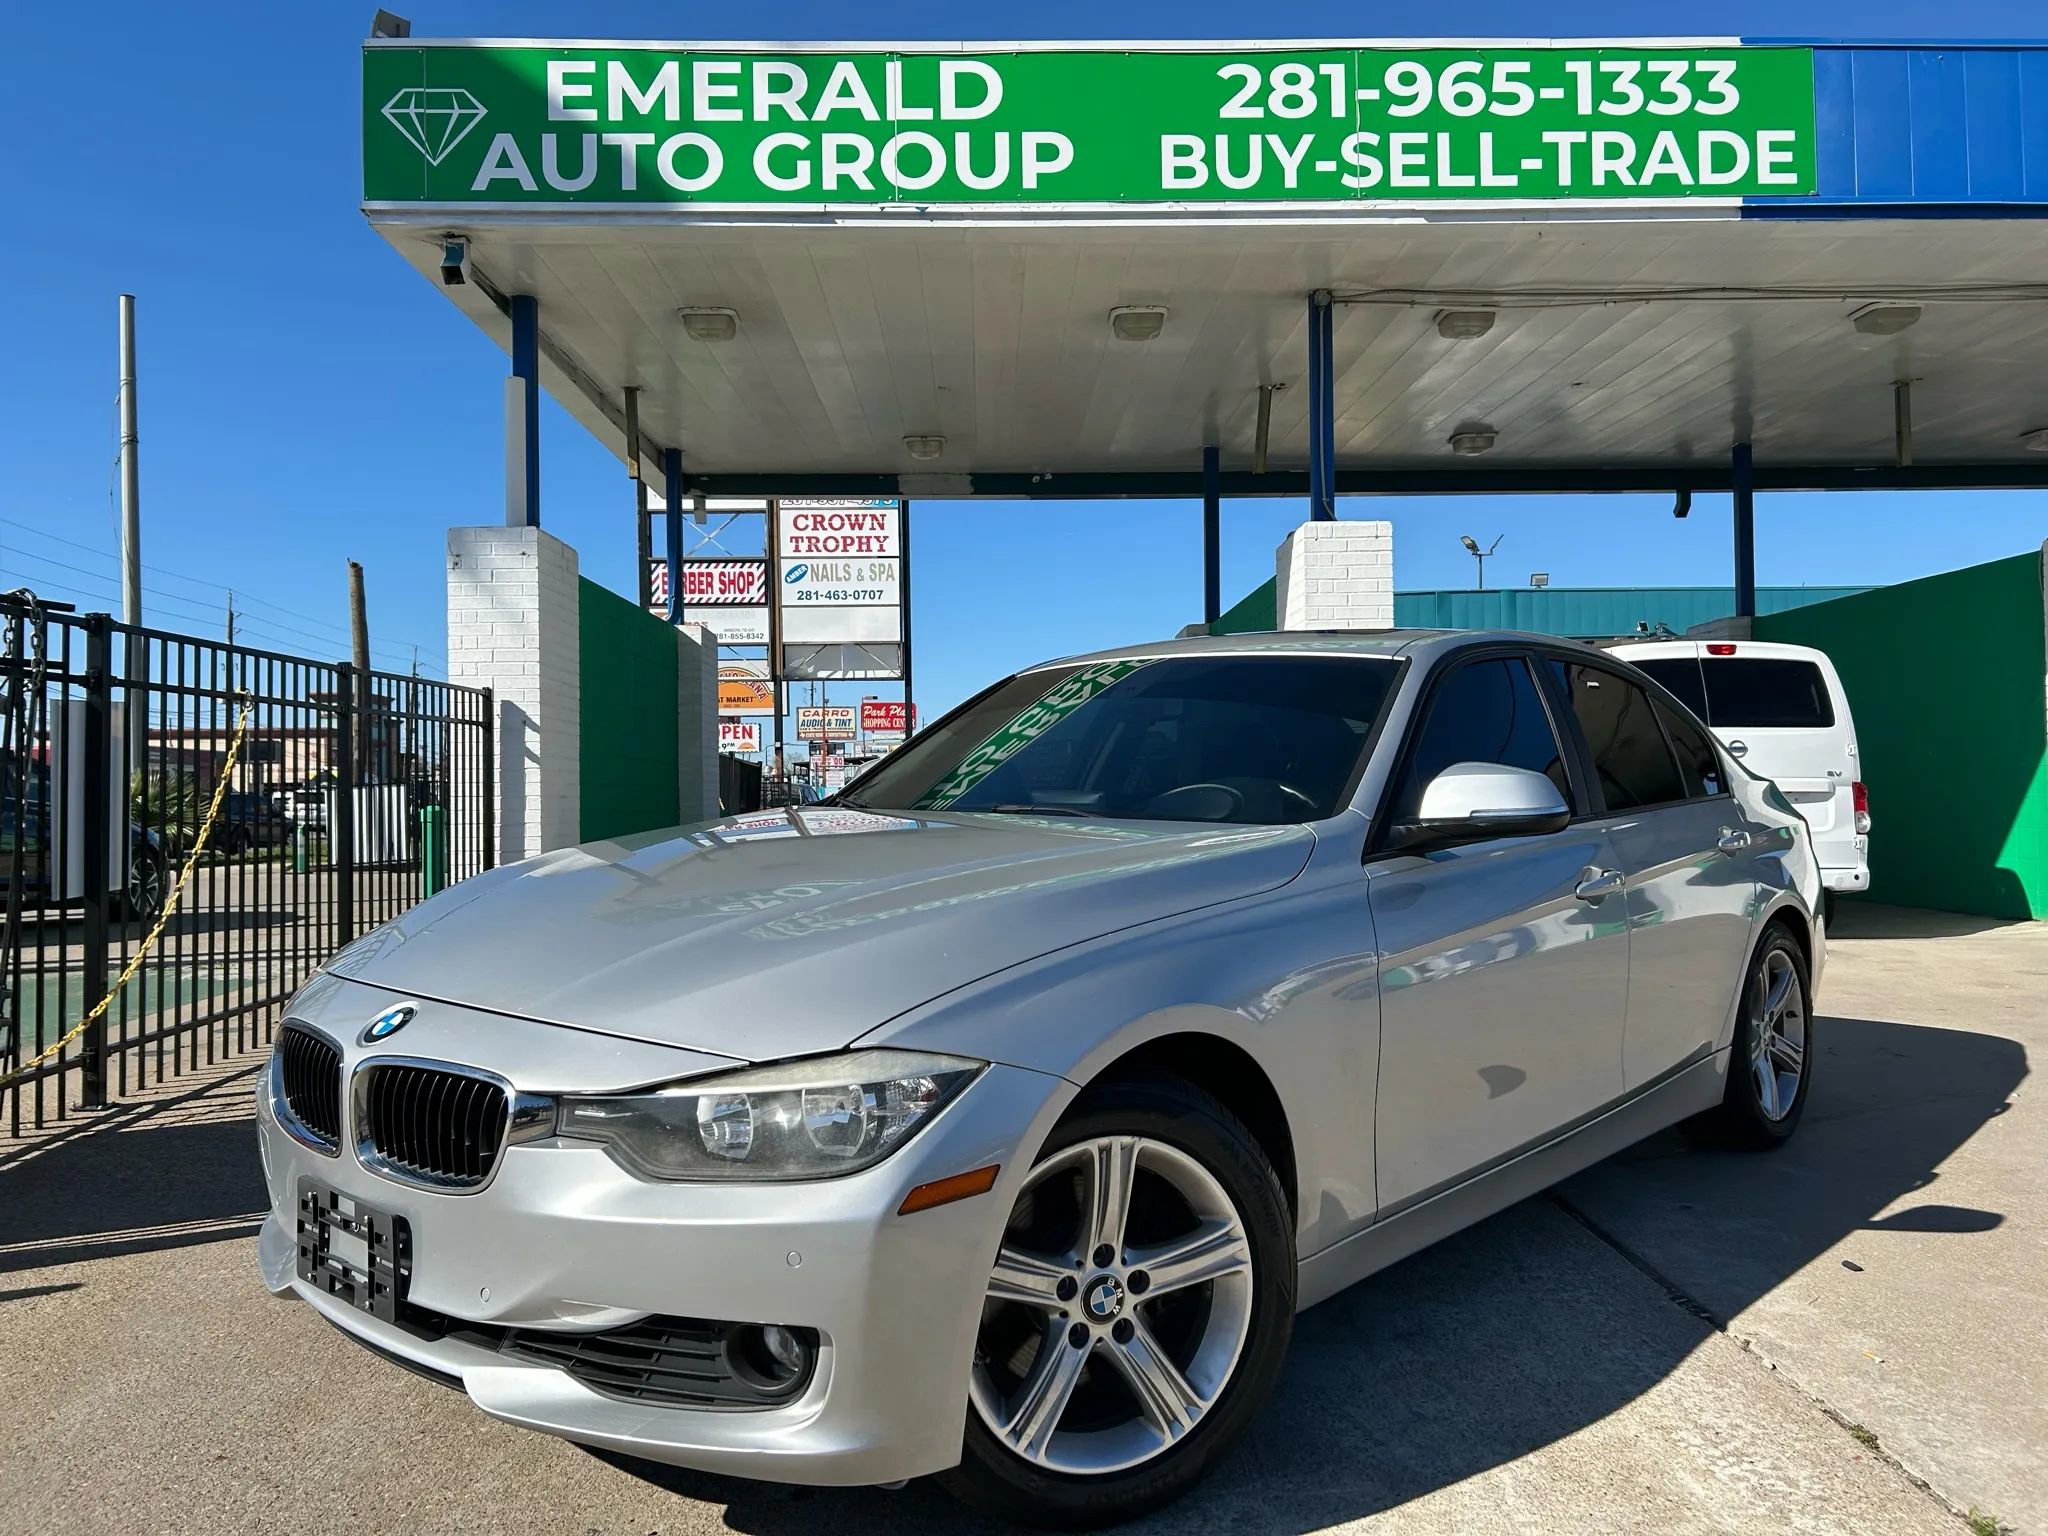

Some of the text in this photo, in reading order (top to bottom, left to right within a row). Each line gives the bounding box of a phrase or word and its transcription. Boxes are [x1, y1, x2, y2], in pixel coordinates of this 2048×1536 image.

[546, 60, 1004, 122] EMERALD
[1216, 60, 1740, 119] 281-965-1333
[470, 130, 1075, 192] AUTO GROUP
[1160, 130, 1798, 190] BUY-SELL-TRADE
[793, 514, 886, 531] CROWN
[790, 536, 889, 553] TROPHY
[785, 565, 808, 583] AMBER
[810, 563, 895, 582] NAILS & SPA
[661, 571, 754, 595] BRBER SHOP
[797, 590, 884, 601] 281-463-0707
[802, 709, 850, 718] CARRO
[863, 705, 886, 717] Park
[826, 719, 833, 727] &
[834, 719, 852, 728] TINT
[718, 725, 753, 740] PEN
